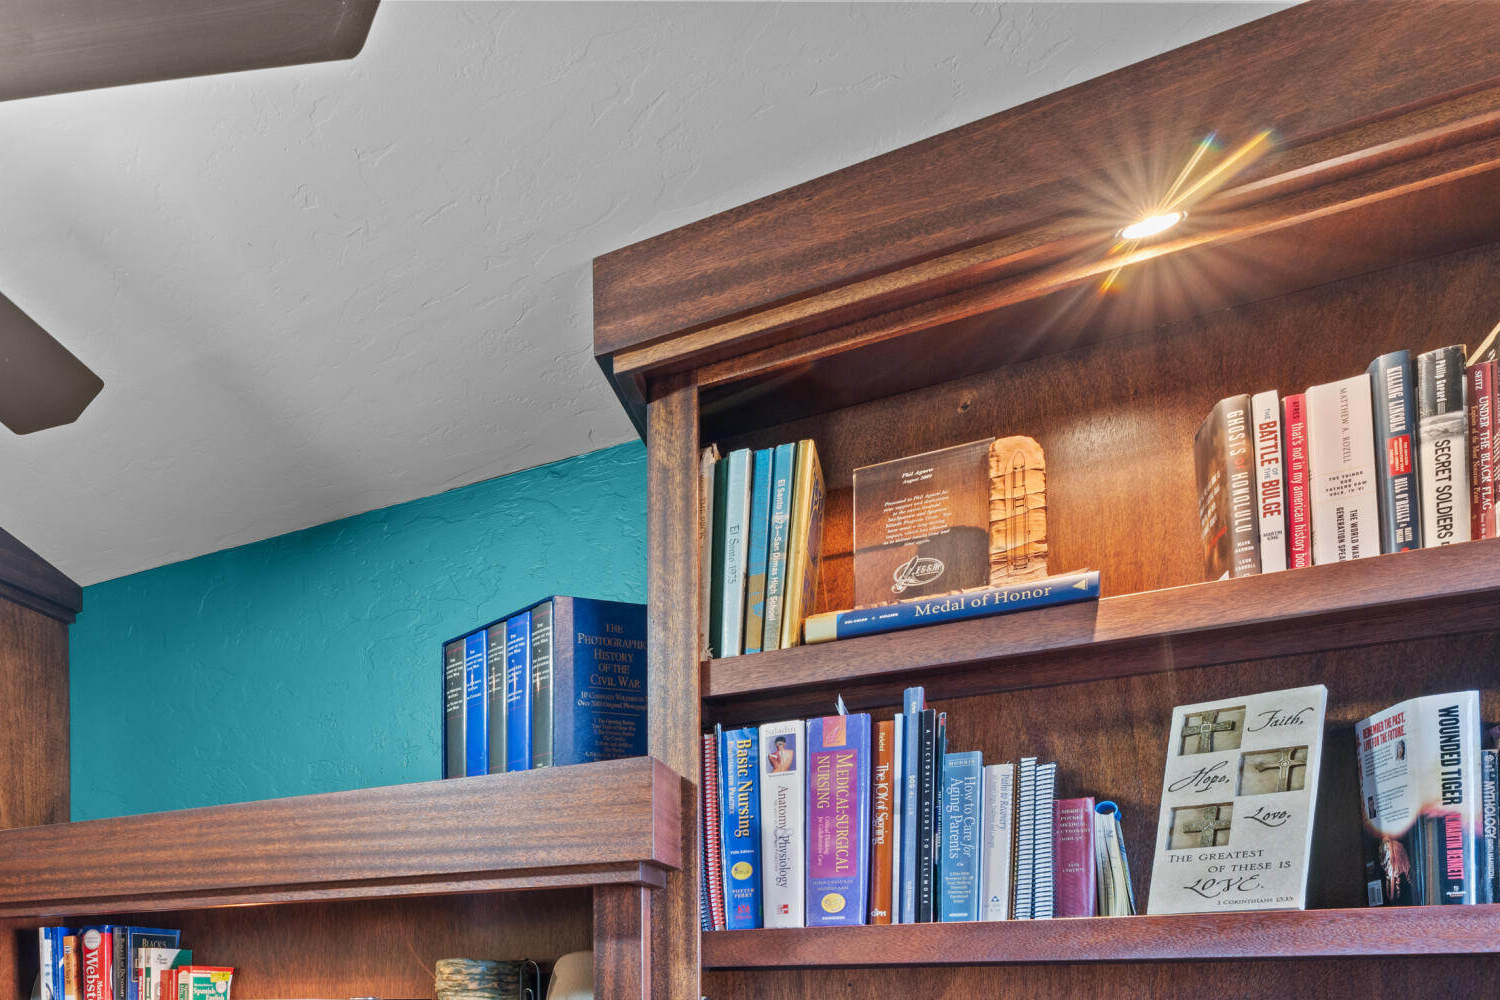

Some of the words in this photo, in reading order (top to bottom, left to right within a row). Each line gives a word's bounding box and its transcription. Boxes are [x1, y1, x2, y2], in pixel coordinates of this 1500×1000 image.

[1435, 359, 1447, 379] Philip
[1474, 370, 1483, 391] SEITZ
[1386, 366, 1404, 399] KILLING
[1436, 379, 1448, 404] Gerard
[1340, 387, 1350, 426] MATTHEW
[1388, 400, 1406, 433] LINCOLN
[1478, 396, 1490, 430] UNDER
[1227, 408, 1247, 457] GHOSTS
[1259, 420, 1279, 467] BATTLE
[1291, 422, 1304, 446] that's
[1480, 430, 1491, 450] THE
[1291, 447, 1302, 460] not
[1341, 435, 1351, 464] ROZELL
[1434, 439, 1452, 482] SECRET
[1233, 457, 1245, 470] OF
[1292, 461, 1305, 471] in
[1480, 452, 1492, 483] BLACK
[1290, 471, 1303, 484] my
[1394, 476, 1409, 493] BILL
[775, 487, 785, 510] Santo
[1231, 471, 1253, 534] HONOLULU
[1261, 479, 1282, 519] BULGE
[1292, 482, 1307, 523] american
[1481, 484, 1493, 511] FLAG
[1350, 508, 1358, 518] THE
[1436, 485, 1454, 540] SOLDIERS
[1292, 523, 1308, 551] history
[1336, 507, 1346, 545] GENERATION
[1350, 519, 1360, 543] WORLD
[769, 553, 781, 576] Dimas
[1295, 553, 1306, 569] boo
[1351, 543, 1361, 561] WAR
[768, 576, 780, 595] High
[766, 594, 778, 621] School
[914, 595, 968, 618] Medal
[970, 591, 991, 610] of
[993, 584, 1053, 607] Honor
[605, 623, 624, 634] THE
[593, 648, 634, 663] HISTORY
[589, 673, 617, 687] CIVIL
[618, 676, 641, 689] WAR
[598, 663, 611, 673] OF
[612, 664, 631, 674] THE
[765, 725, 796, 737] Saladin
[1247, 706, 1315, 733] Faith,
[1362, 716, 1385, 740] REMEMBER
[1384, 714, 1393, 730] THE
[1392, 711, 1406, 727] PAST.
[1363, 737, 1372, 752] LIVE
[1372, 735, 1380, 749] FOR
[1380, 732, 1388, 746] THE
[1388, 725, 1407, 744] FUTURE.
[1438, 704, 1462, 766] WOUNDED
[736, 739, 752, 777] Basic
[816, 755, 831, 809] NURSING
[875, 763, 890, 781] The
[1167, 760, 1231, 794] Hope,
[875, 781, 890, 799] JOY
[945, 778, 964, 812] Aging
[963, 776, 977, 798] How
[1440, 770, 1463, 806] TIGER
[734, 781, 754, 838] Nursing
[776, 785, 789, 830] Anatomy
[835, 753, 854, 873] MEDICAL-SURGICAL
[875, 799, 889, 812] of
[963, 802, 974, 815] to
[1243, 805, 1293, 828] Love.
[1483, 781, 1496, 840] MYTHOLOGY
[871, 812, 889, 846] Signing
[949, 815, 964, 859] Parents
[963, 816, 976, 842] Care
[923, 836, 929, 849] TO
[962, 842, 976, 858] for
[775, 835, 790, 888] Physiology
[1169, 854, 1195, 864] THE
[1198, 850, 1265, 862] GREATEST
[1207, 863, 1226, 874] OF
[1229, 862, 1273, 873] THESE
[1279, 859, 1292, 870] IS
[1183, 874, 1265, 899] LOVE.
[1223, 896, 1274, 906] CORINTHIANS
[193, 986, 216, 996] Spanish
